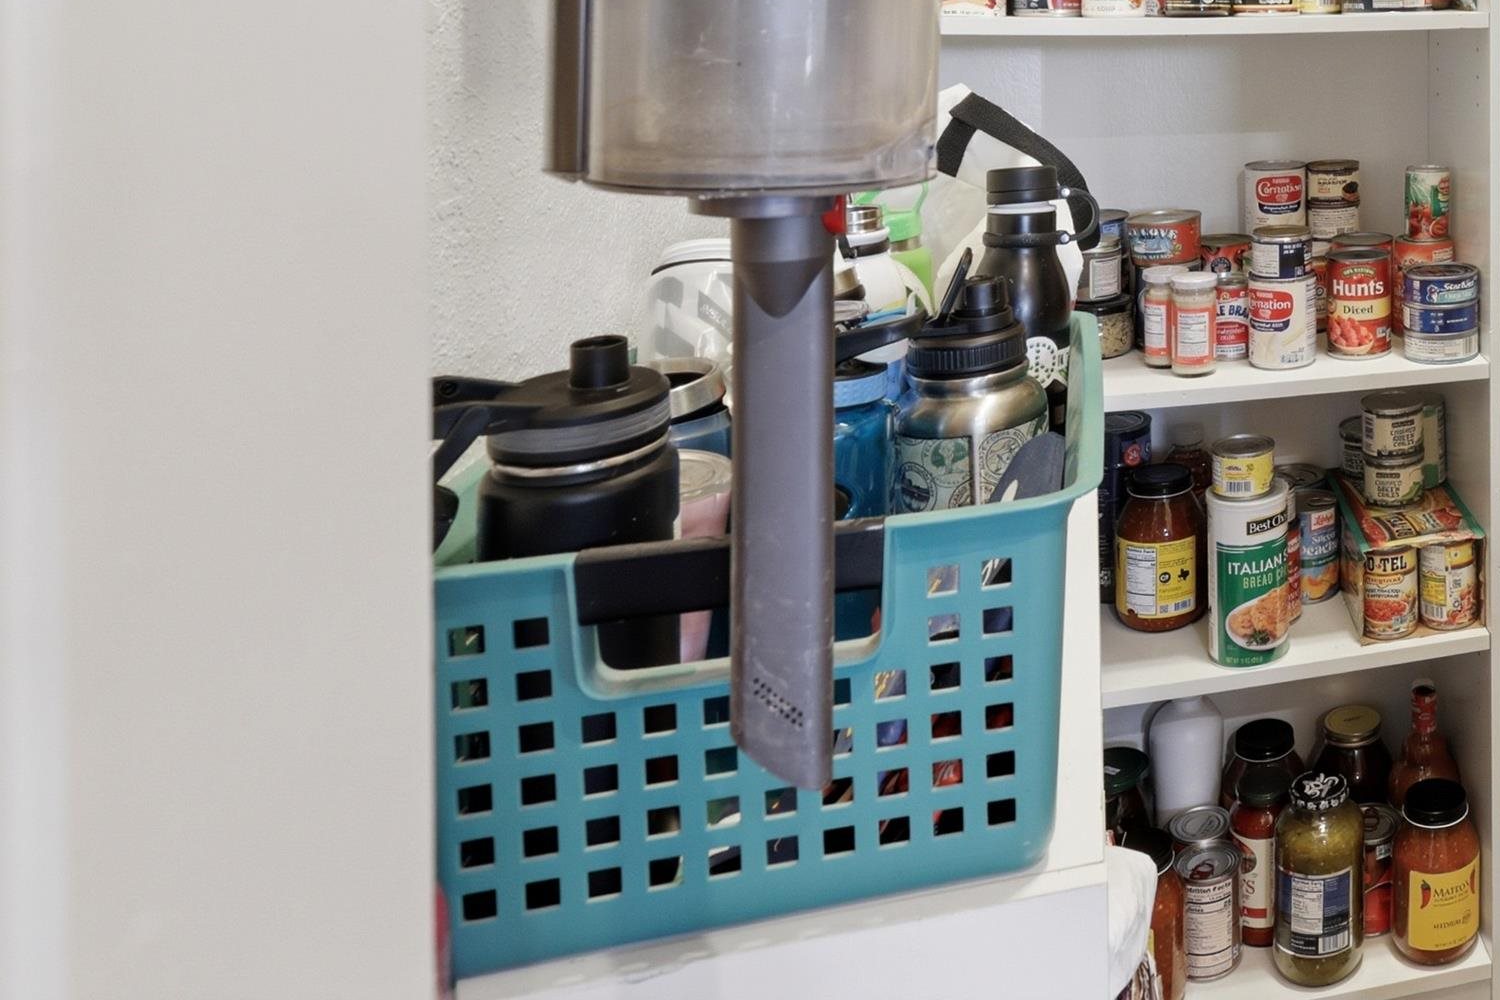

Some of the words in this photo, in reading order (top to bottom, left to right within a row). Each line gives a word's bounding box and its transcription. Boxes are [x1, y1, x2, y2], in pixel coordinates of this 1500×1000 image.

[1258, 182, 1303, 197] Carnation
[1343, 305, 1374, 315] Diced
[1250, 520, 1271, 534] Best
[1227, 552, 1282, 576] ITALIAN
[1243, 573, 1273, 589] BREAD
